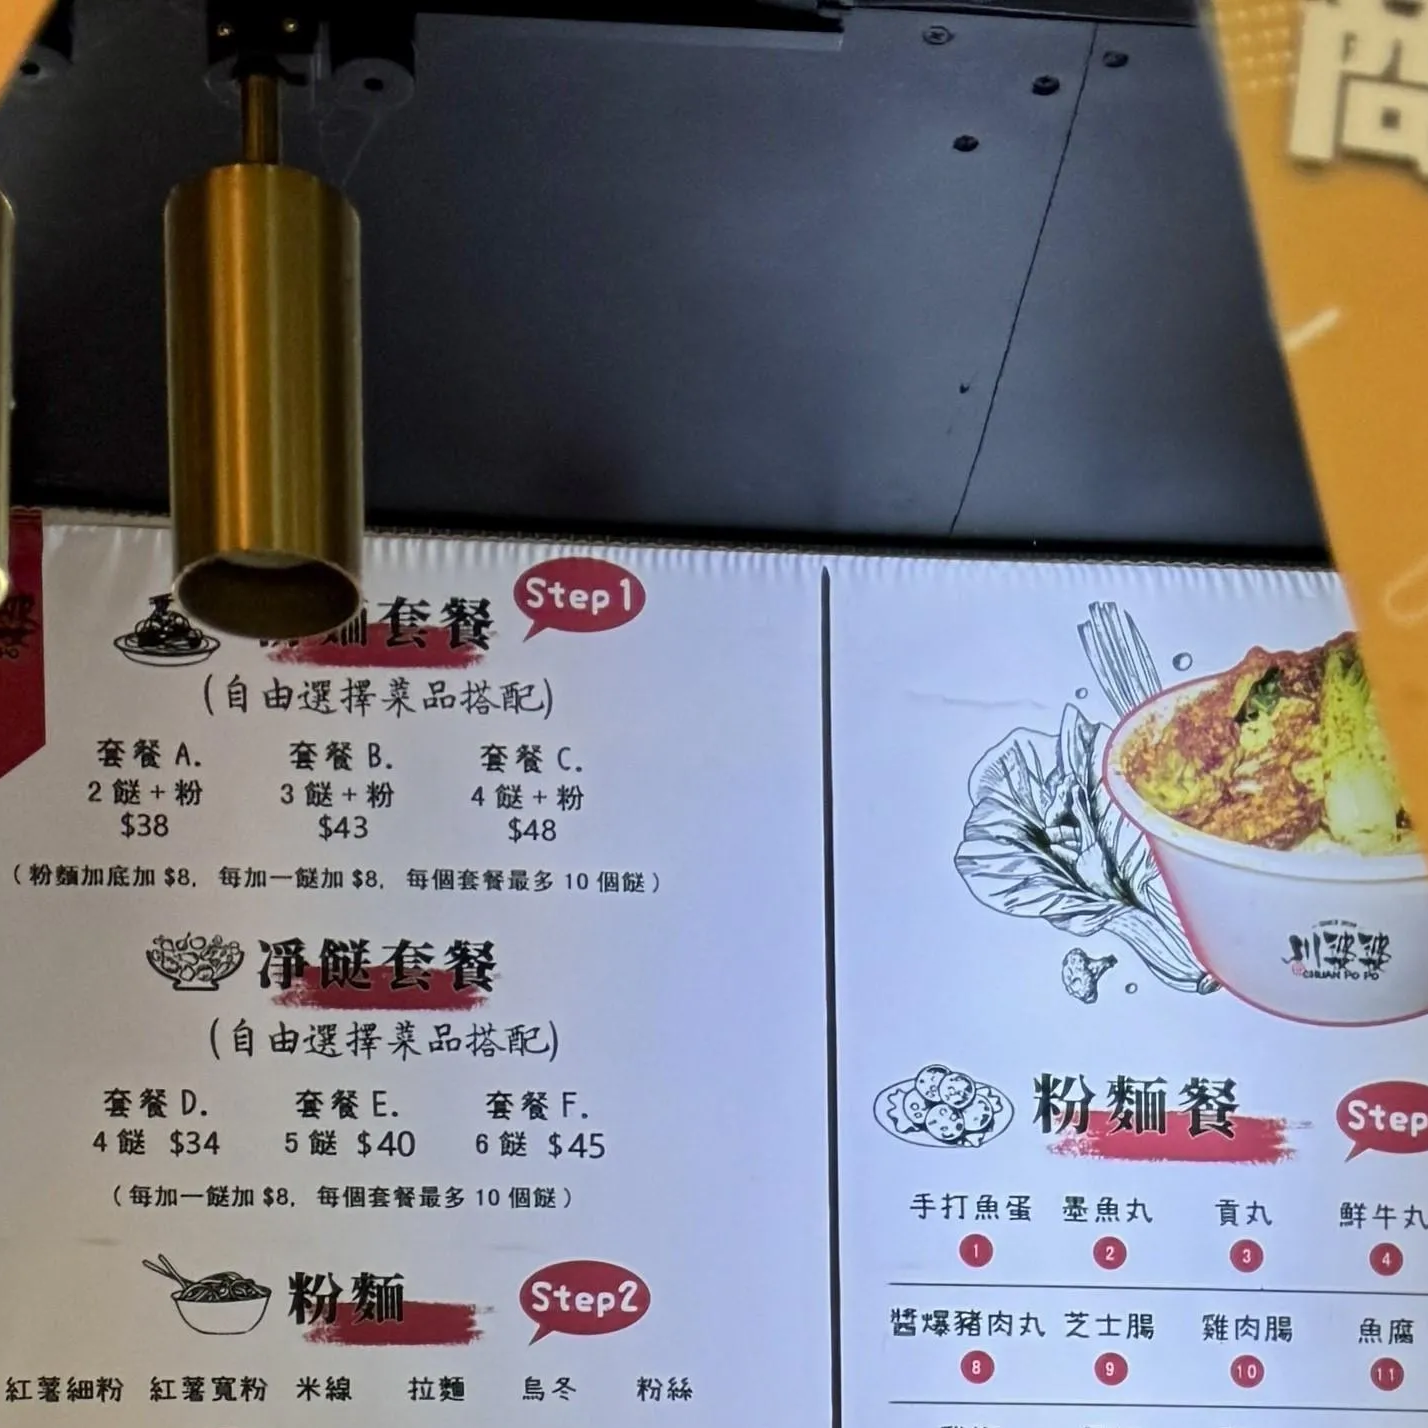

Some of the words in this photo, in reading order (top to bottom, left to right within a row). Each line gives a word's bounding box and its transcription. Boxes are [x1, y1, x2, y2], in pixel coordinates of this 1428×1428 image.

[203, 673, 553, 721] (自由選擇菜品搭配)
[96, 737, 161, 769] 套餐
[174, 741, 202, 768] A.
[289, 740, 353, 772] 套餐
[367, 742, 393, 770] B.
[480, 743, 543, 774] 套餐
[556, 746, 583, 773] C.
[120, 811, 169, 839] $38
[318, 813, 369, 842] $43
[508, 816, 557, 844] $48
[219, 865, 344, 890] 每加一餸加
[406, 867, 554, 893] 每個套餐最多
[565, 872, 589, 891] 10
[257, 936, 500, 992] 凈餸套餐
[209, 1017, 559, 1063] (自由選擇菜品搭配)
[1033, 1074, 1238, 1136] 粉麵餐
[169, 1128, 221, 1158] $34
[357, 1129, 416, 1158] $40
[548, 1131, 606, 1160] $45
[909, 1192, 1032, 1222] 手打魚蛋
[1062, 1195, 1153, 1224] 墨魚丸
[1214, 1198, 1273, 1227] 貢丸
[287, 1271, 405, 1325] 粉麵
[5, 1375, 124, 1403] 紅薯細粉
[149, 1375, 268, 1403] 紅薯寬粉
[296, 1375, 353, 1402] 米線
[407, 1375, 465, 1402] 拉麵
[522, 1375, 577, 1402] 烏冬
[636, 1376, 693, 1402] 粉絲
